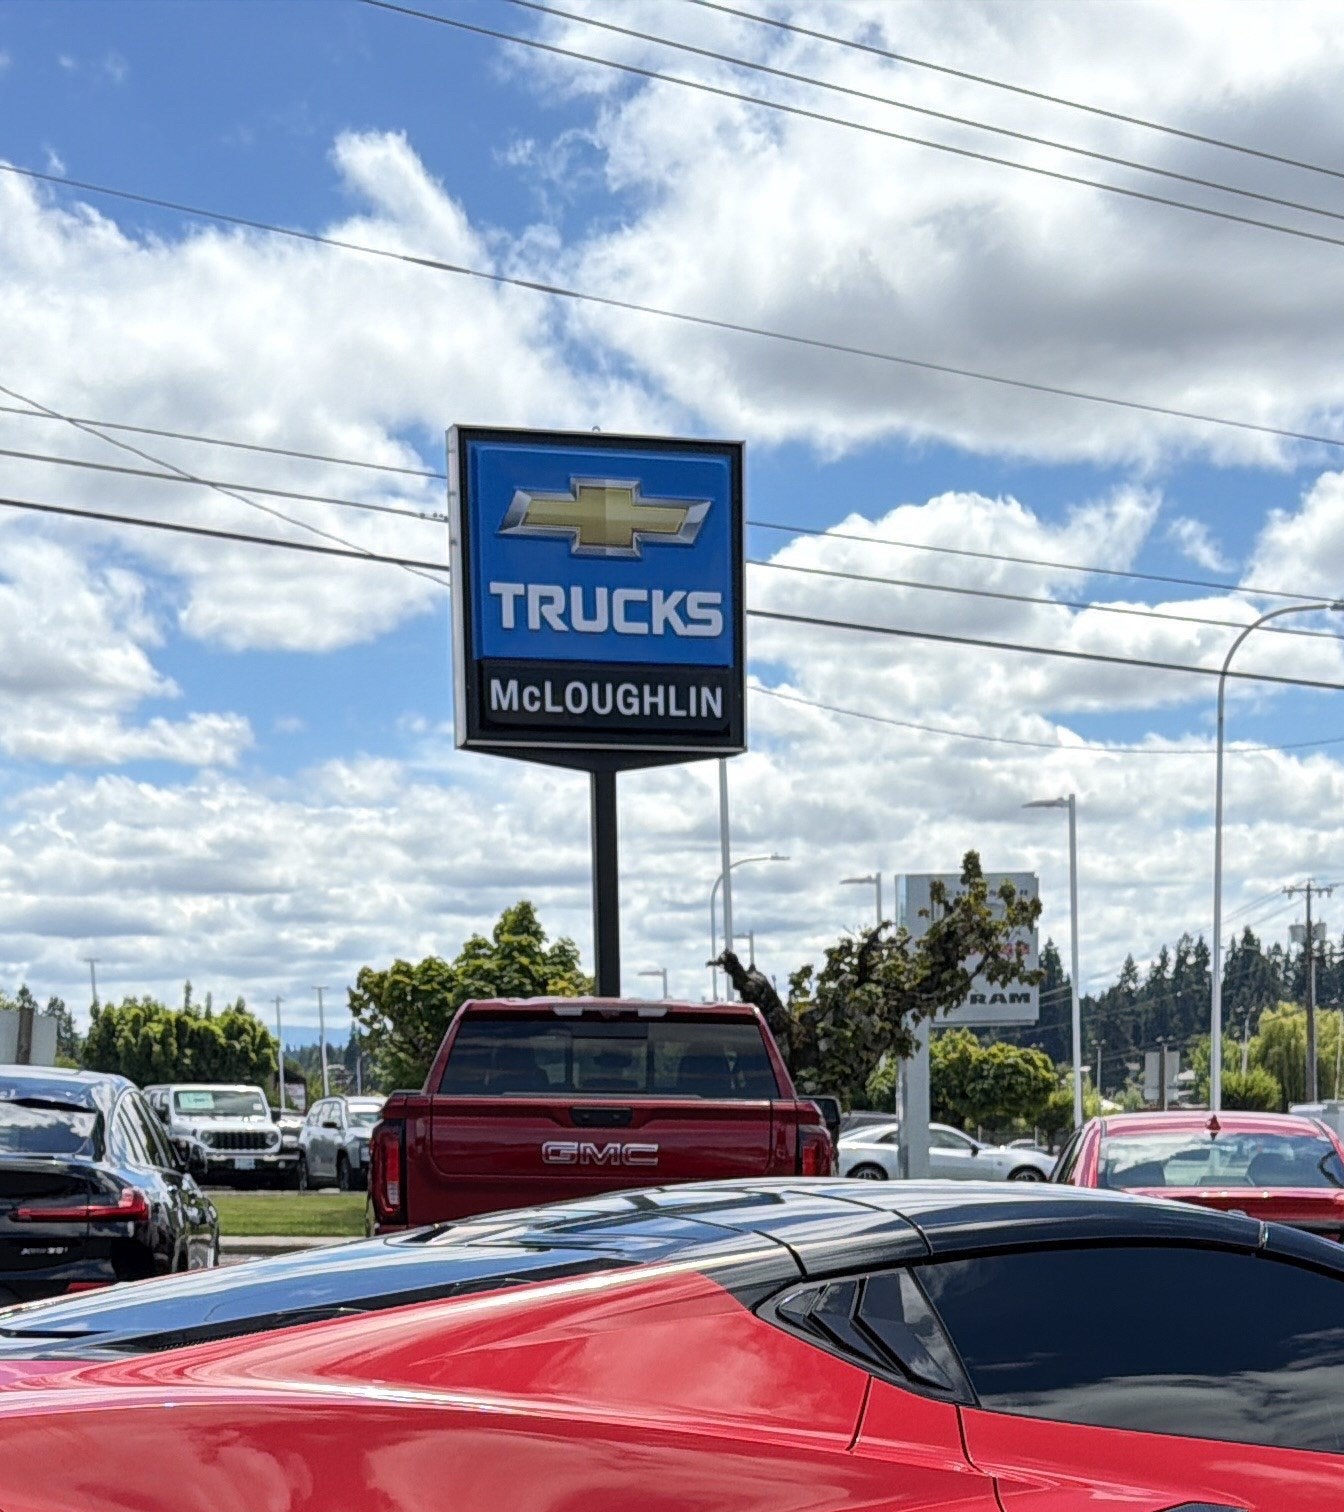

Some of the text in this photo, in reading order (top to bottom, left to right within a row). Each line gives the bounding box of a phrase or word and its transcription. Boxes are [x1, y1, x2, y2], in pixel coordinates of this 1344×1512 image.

[490, 582, 723, 637] TRUCKS
[491, 679, 723, 718] McLOUGHLIN
[969, 992, 1031, 1004] RAM
[541, 1140, 659, 1166] GMC
